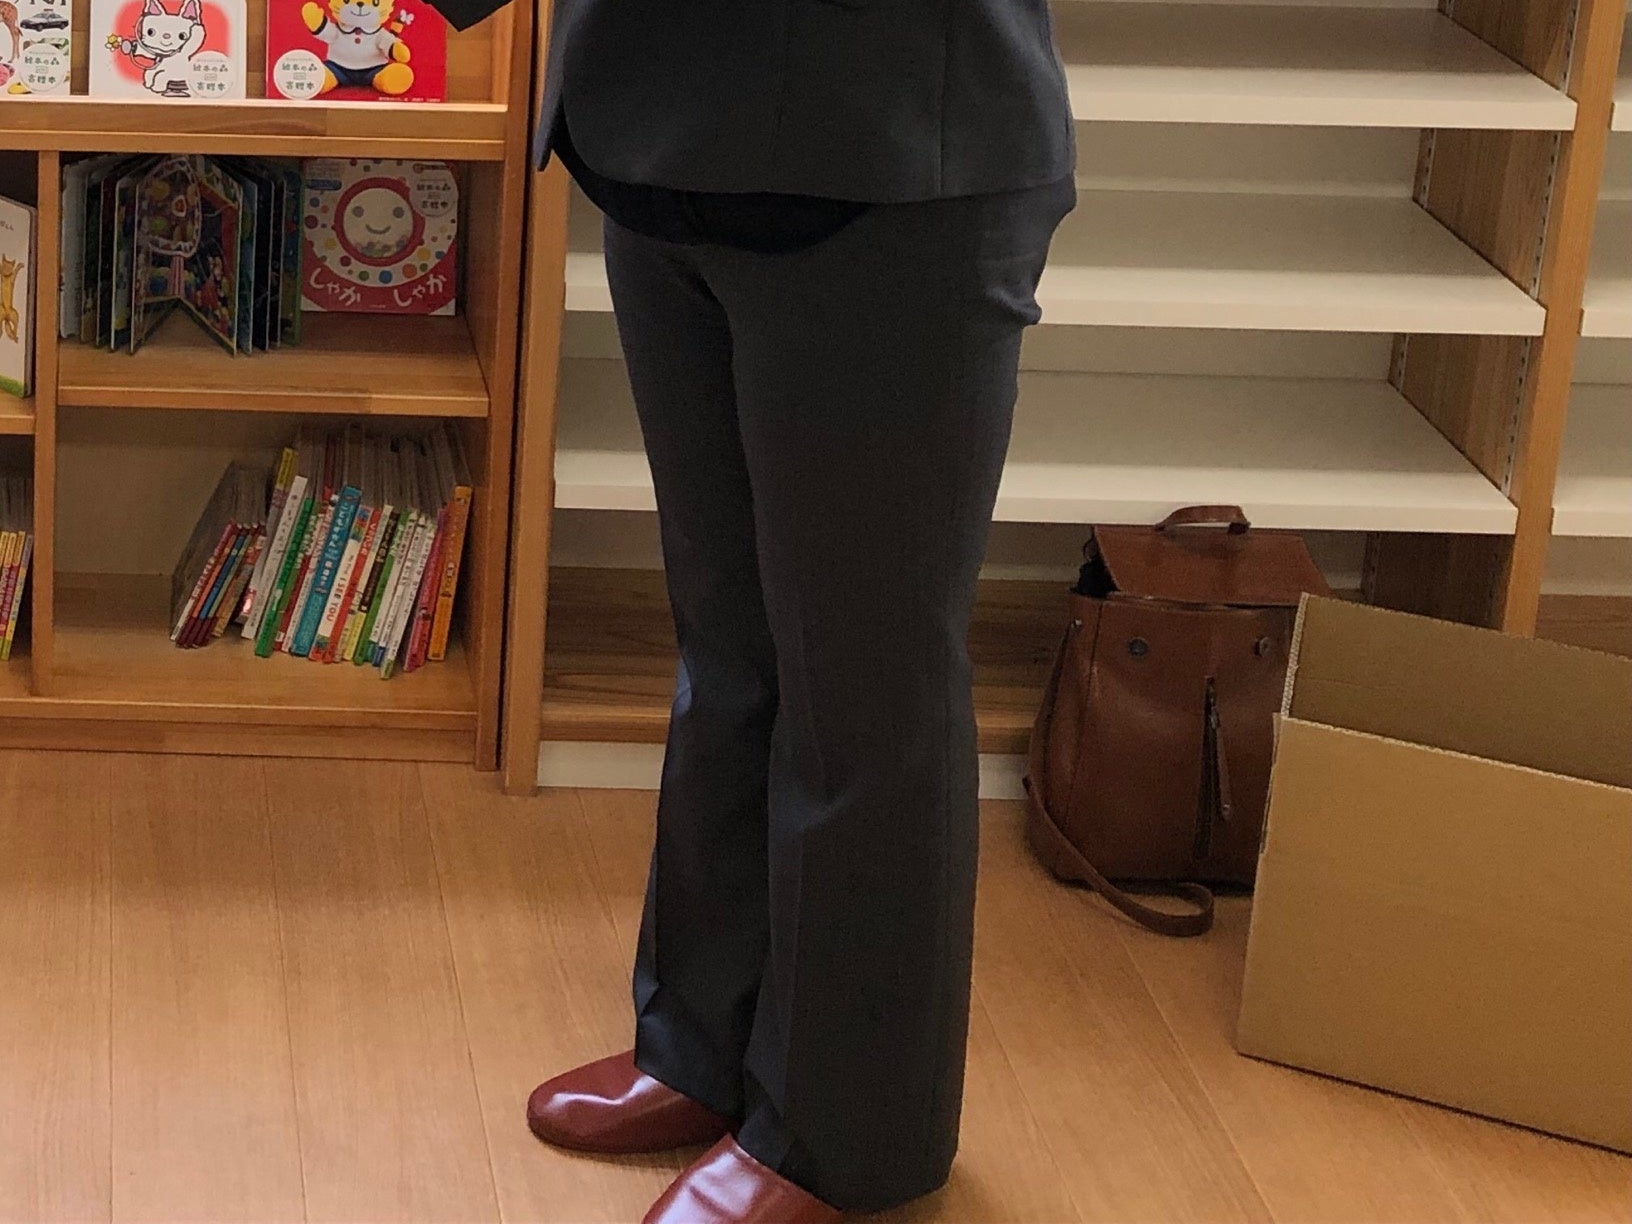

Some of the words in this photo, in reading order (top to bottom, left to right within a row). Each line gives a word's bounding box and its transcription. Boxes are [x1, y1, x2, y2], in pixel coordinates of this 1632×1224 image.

[309, 267, 362, 307] しゃか
[393, 274, 447, 307] しゃか
